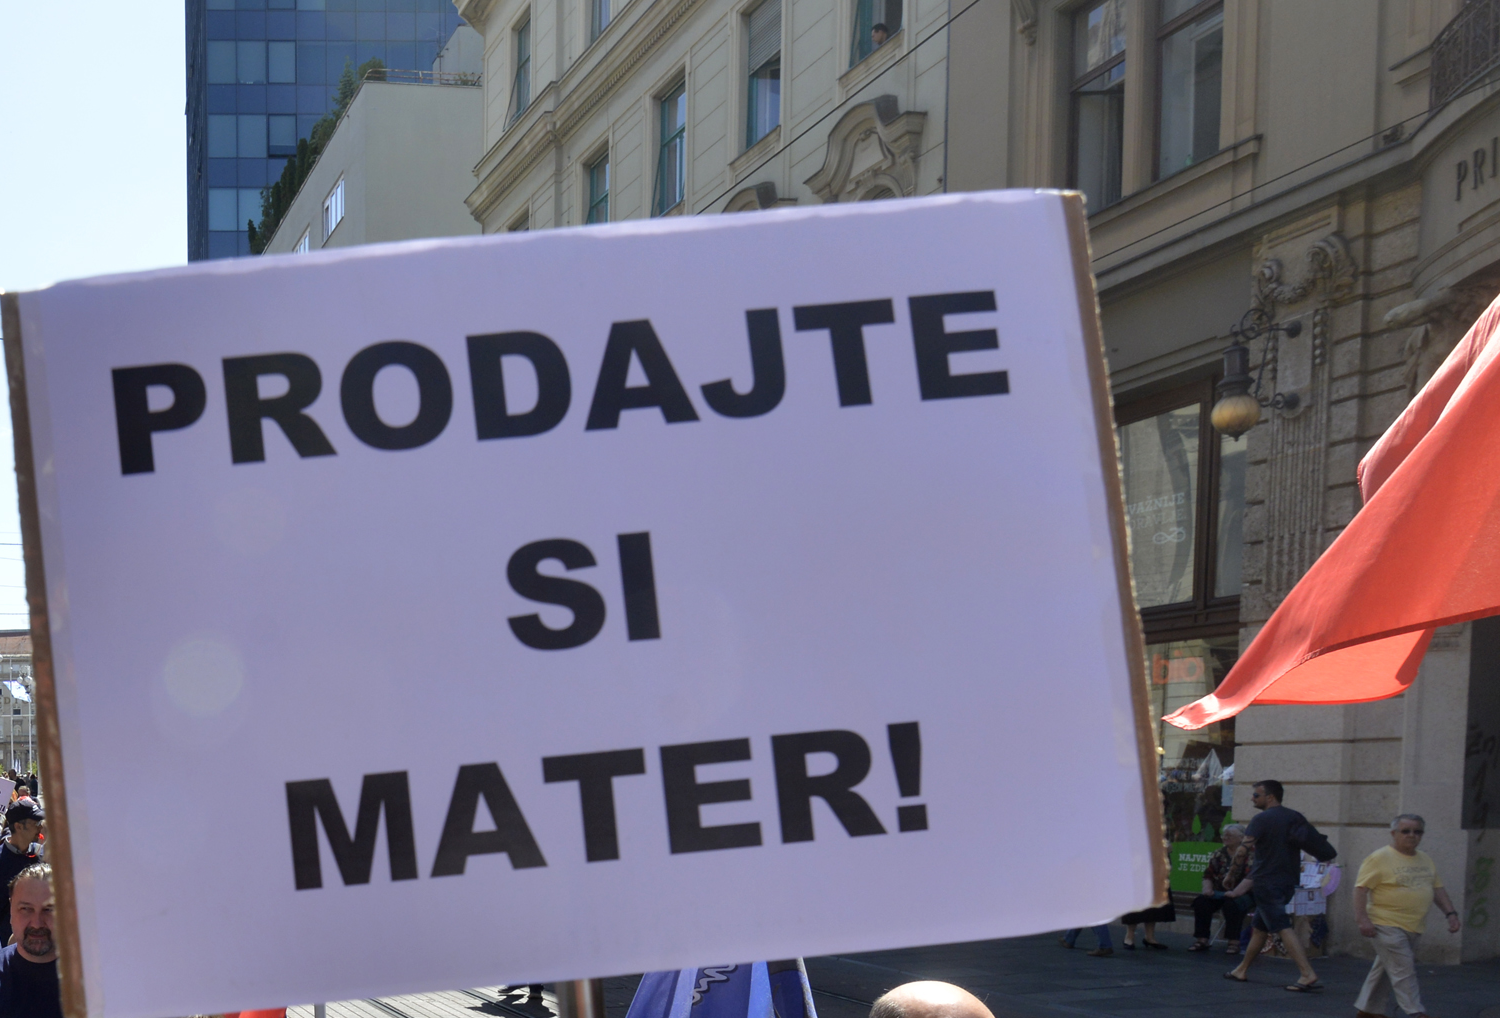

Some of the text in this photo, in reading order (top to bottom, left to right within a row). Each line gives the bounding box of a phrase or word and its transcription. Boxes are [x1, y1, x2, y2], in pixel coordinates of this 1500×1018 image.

[111, 289, 1011, 476] PRODAJTE
[504, 531, 663, 652] SI
[284, 720, 930, 892] MATER!
